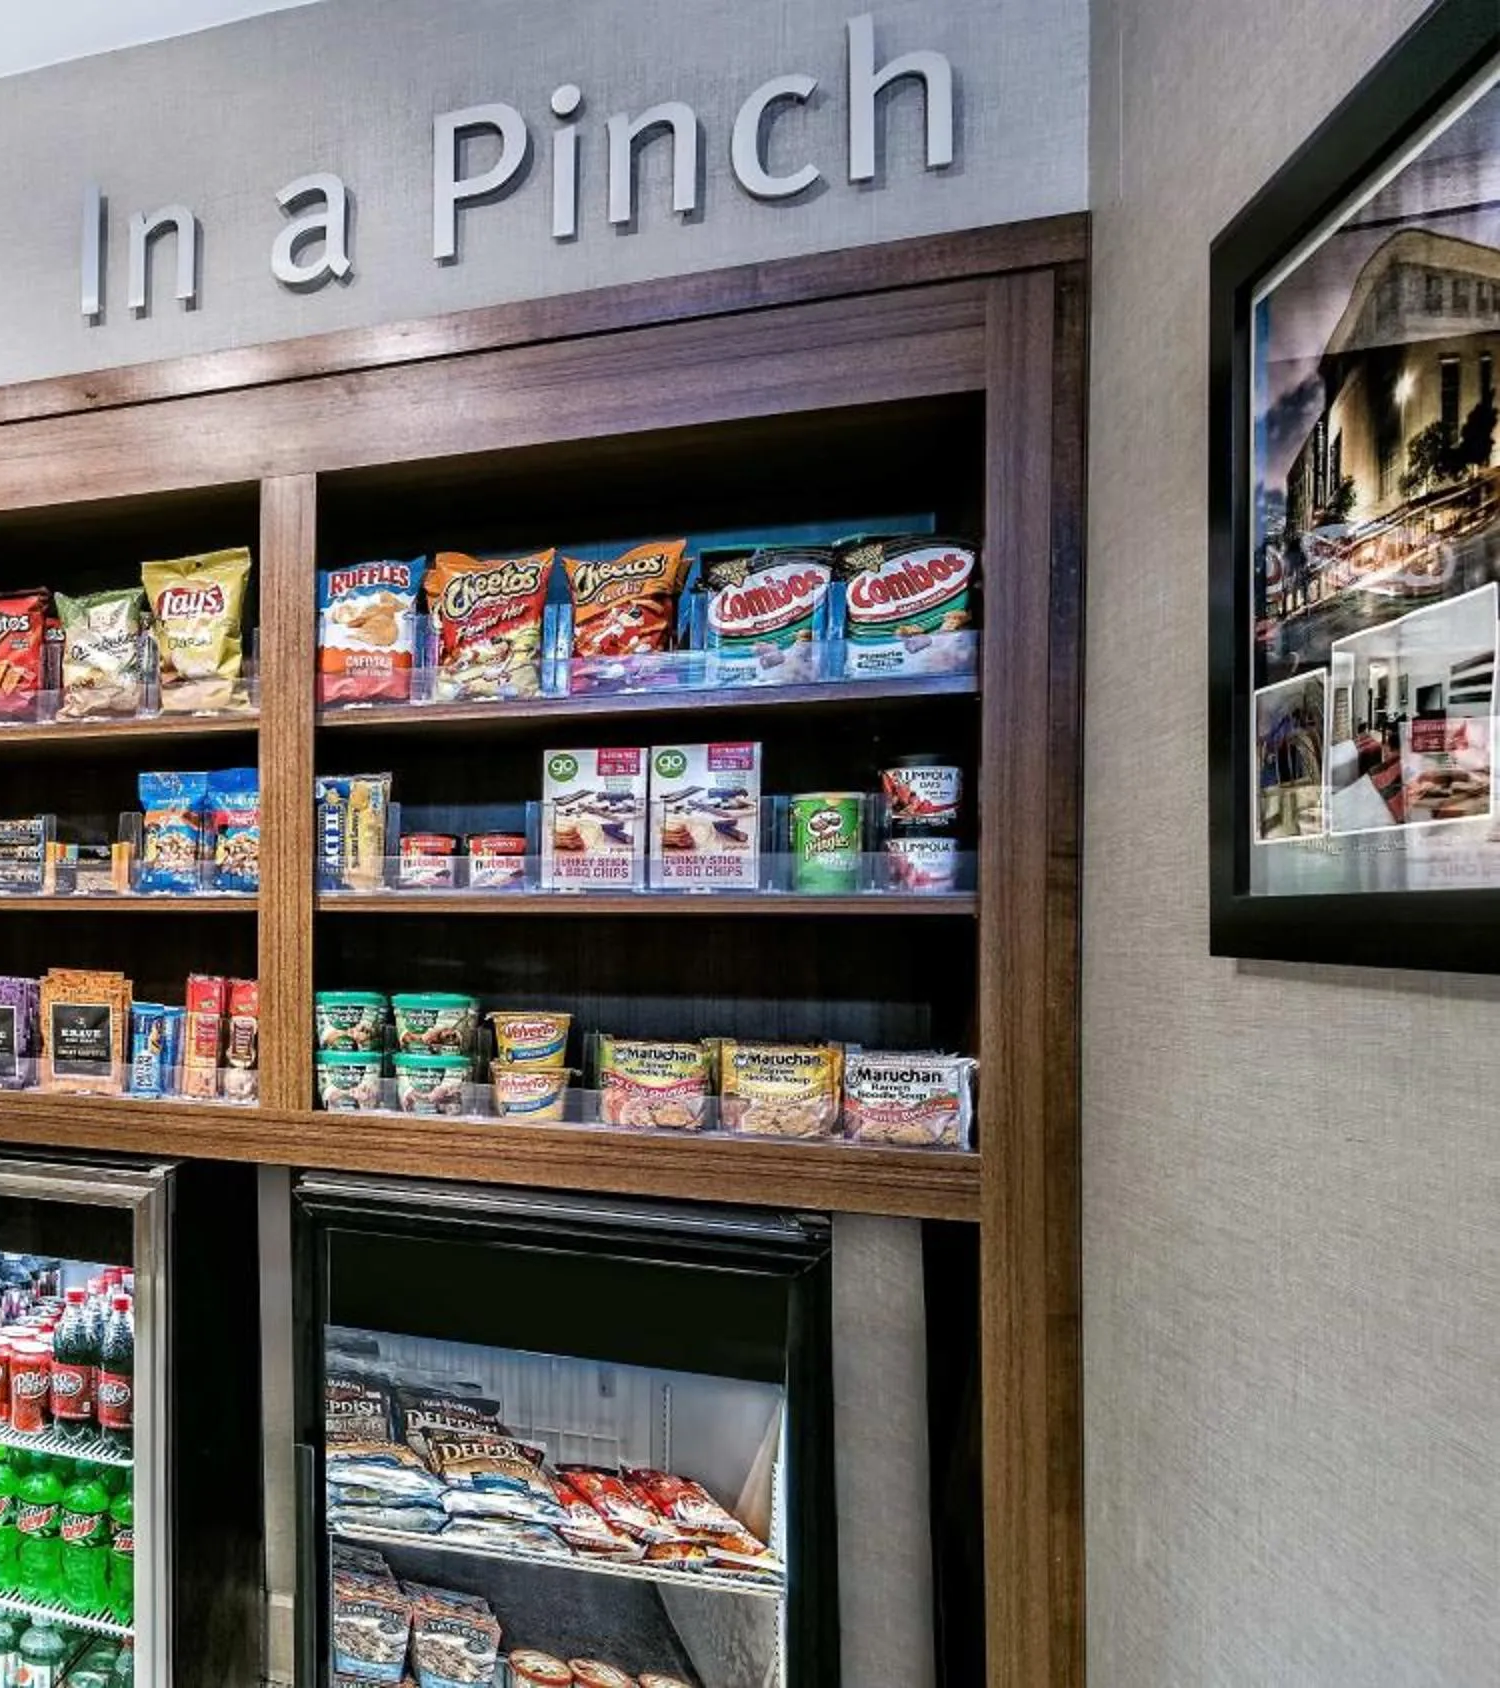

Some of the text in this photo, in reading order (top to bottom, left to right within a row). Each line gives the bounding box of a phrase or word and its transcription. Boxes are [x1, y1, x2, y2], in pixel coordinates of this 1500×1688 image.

[81, 12, 955, 319] In a Pinch
[331, 564, 409, 598] RUFFLES
[850, 553, 966, 609] Combos
[443, 562, 540, 619] Cheetos
[717, 569, 824, 622] Combos
[162, 586, 226, 621] Lay's
[551, 760, 573, 775] go
[658, 755, 683, 771] go
[325, 813, 339, 866] ACT II
[403, 857, 452, 869] nutella
[475, 857, 526, 870] nutella
[555, 857, 630, 867] TURKEY STICK
[664, 856, 742, 867] TURKEY STICK
[593, 868, 630, 879] CHIPS
[705, 866, 743, 877] CHIPS
[61, 1028, 101, 1038] KRAVE
[628, 1049, 697, 1062] Maruchan
[750, 1054, 822, 1067] Maruchan
[857, 1066, 942, 1084] Maruchan
[900, 1091, 928, 1101] Soup
[327, 1401, 382, 1416] PDISH
